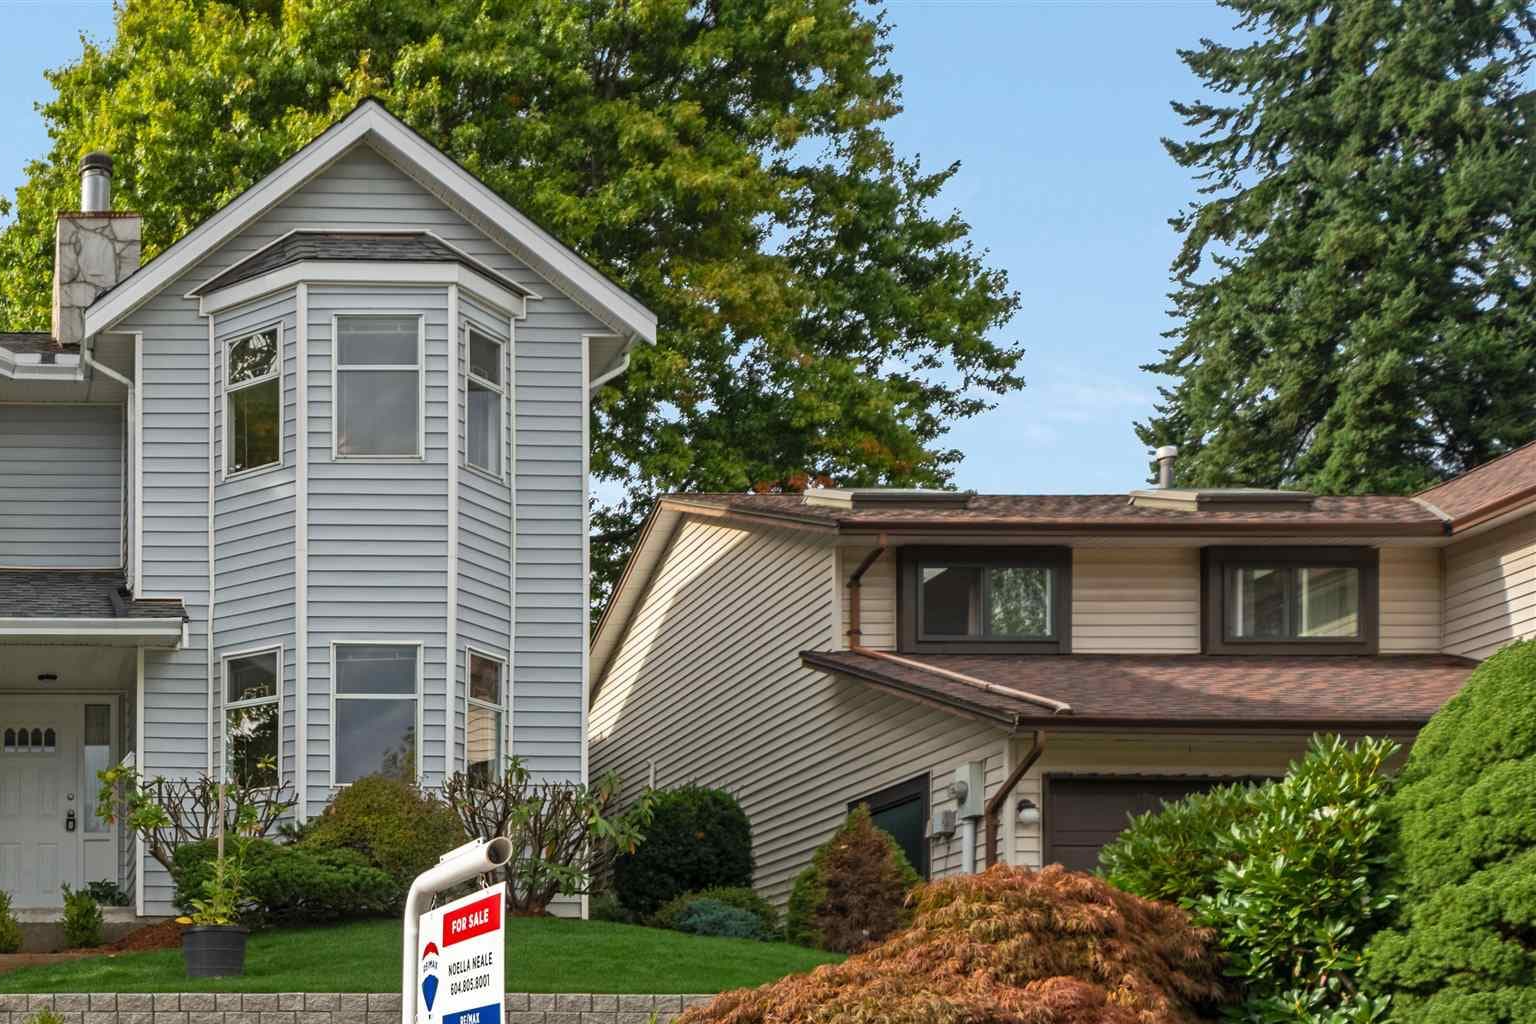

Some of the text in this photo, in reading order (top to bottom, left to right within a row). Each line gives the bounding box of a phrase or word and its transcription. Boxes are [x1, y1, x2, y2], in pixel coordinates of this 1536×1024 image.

[451, 908, 489, 935] FOR SALE
[448, 952, 493, 976] NOELLA NEALE
